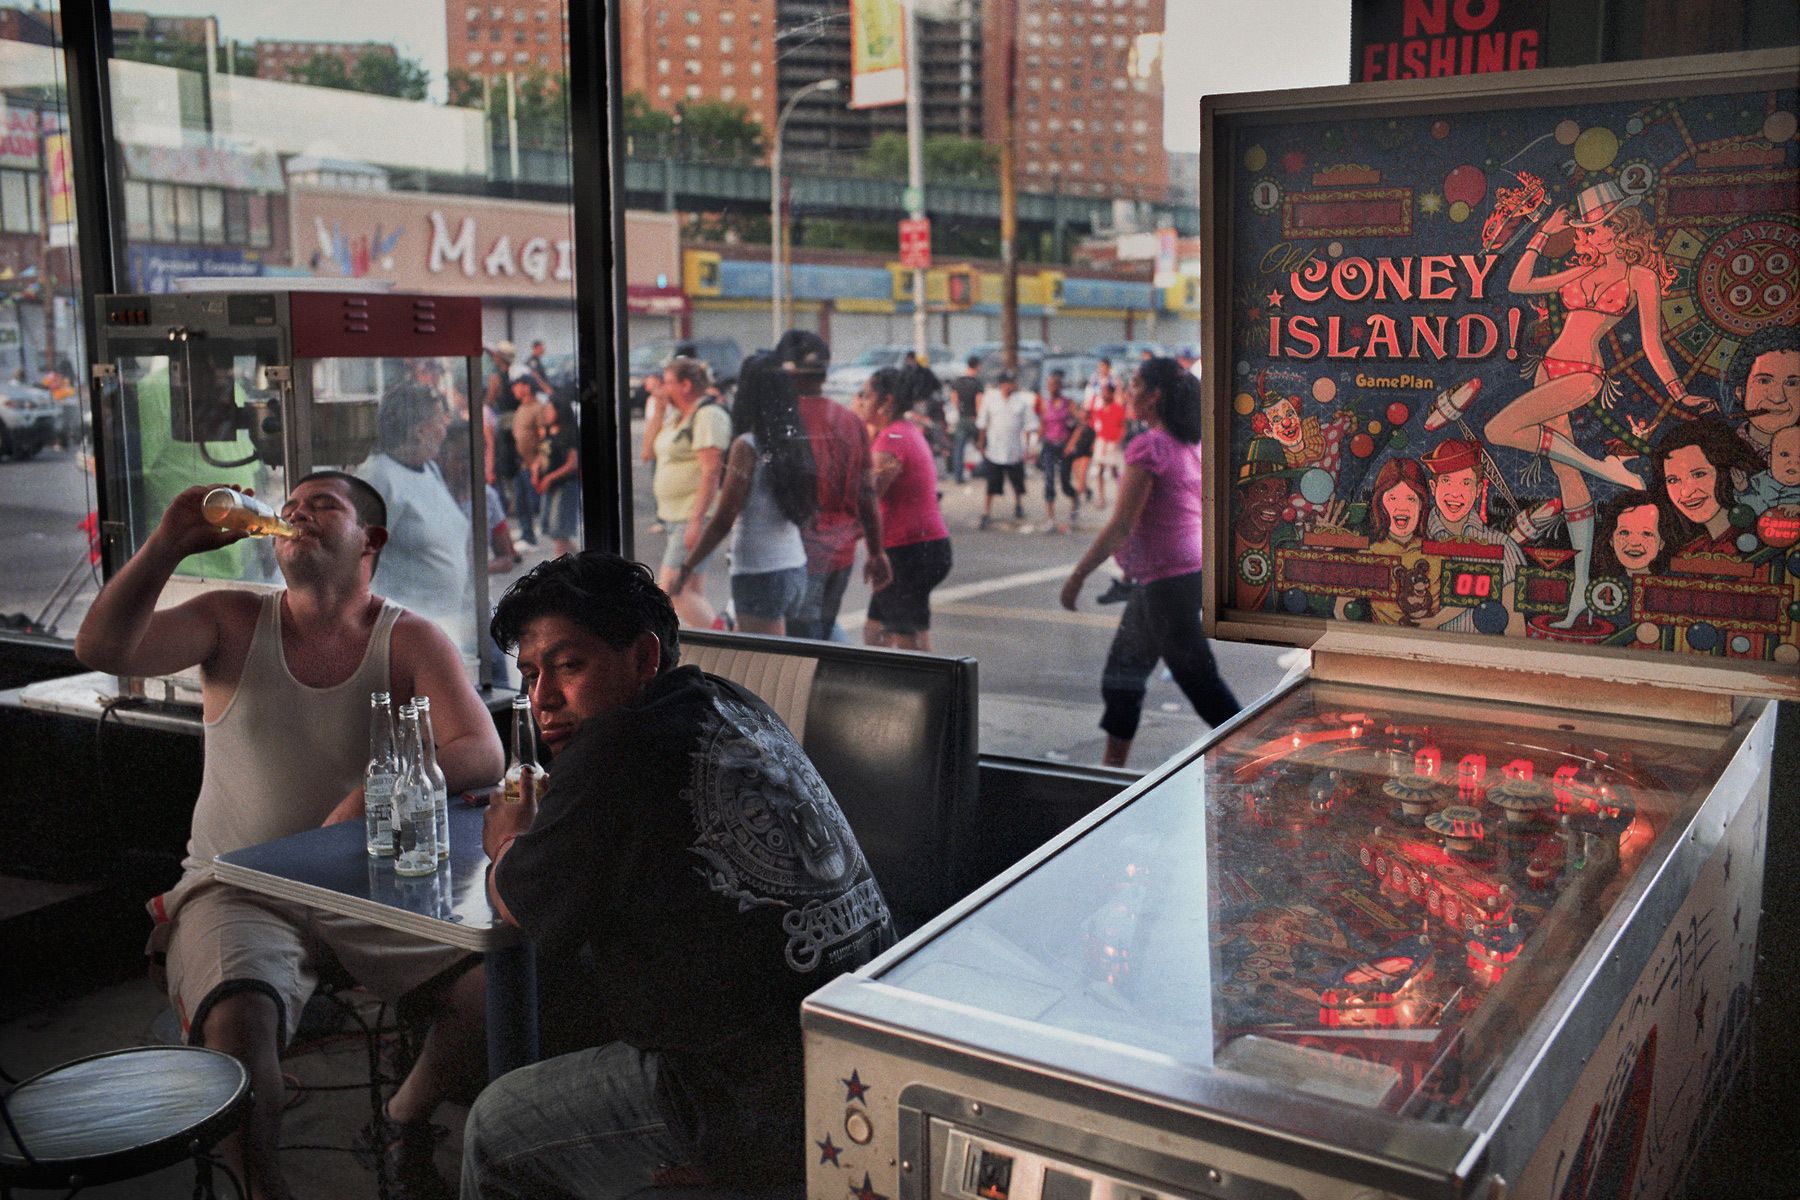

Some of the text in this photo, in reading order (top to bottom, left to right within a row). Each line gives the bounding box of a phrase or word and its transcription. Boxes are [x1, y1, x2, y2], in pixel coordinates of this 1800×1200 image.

[1403, 0, 1500, 37] NO
[1363, 29, 1538, 83] FISHING
[1626, 166, 1648, 189] 2
[1260, 241, 1318, 274] Old
[1290, 254, 1499, 301] CONEY
[1268, 307, 1521, 361] ISLAND!
[1759, 516, 1800, 529] Game
[1764, 527, 1798, 539] Over
[1247, 557, 1263, 577] 3
[1455, 573, 1491, 597] 00
[1597, 585, 1617, 606] 4
